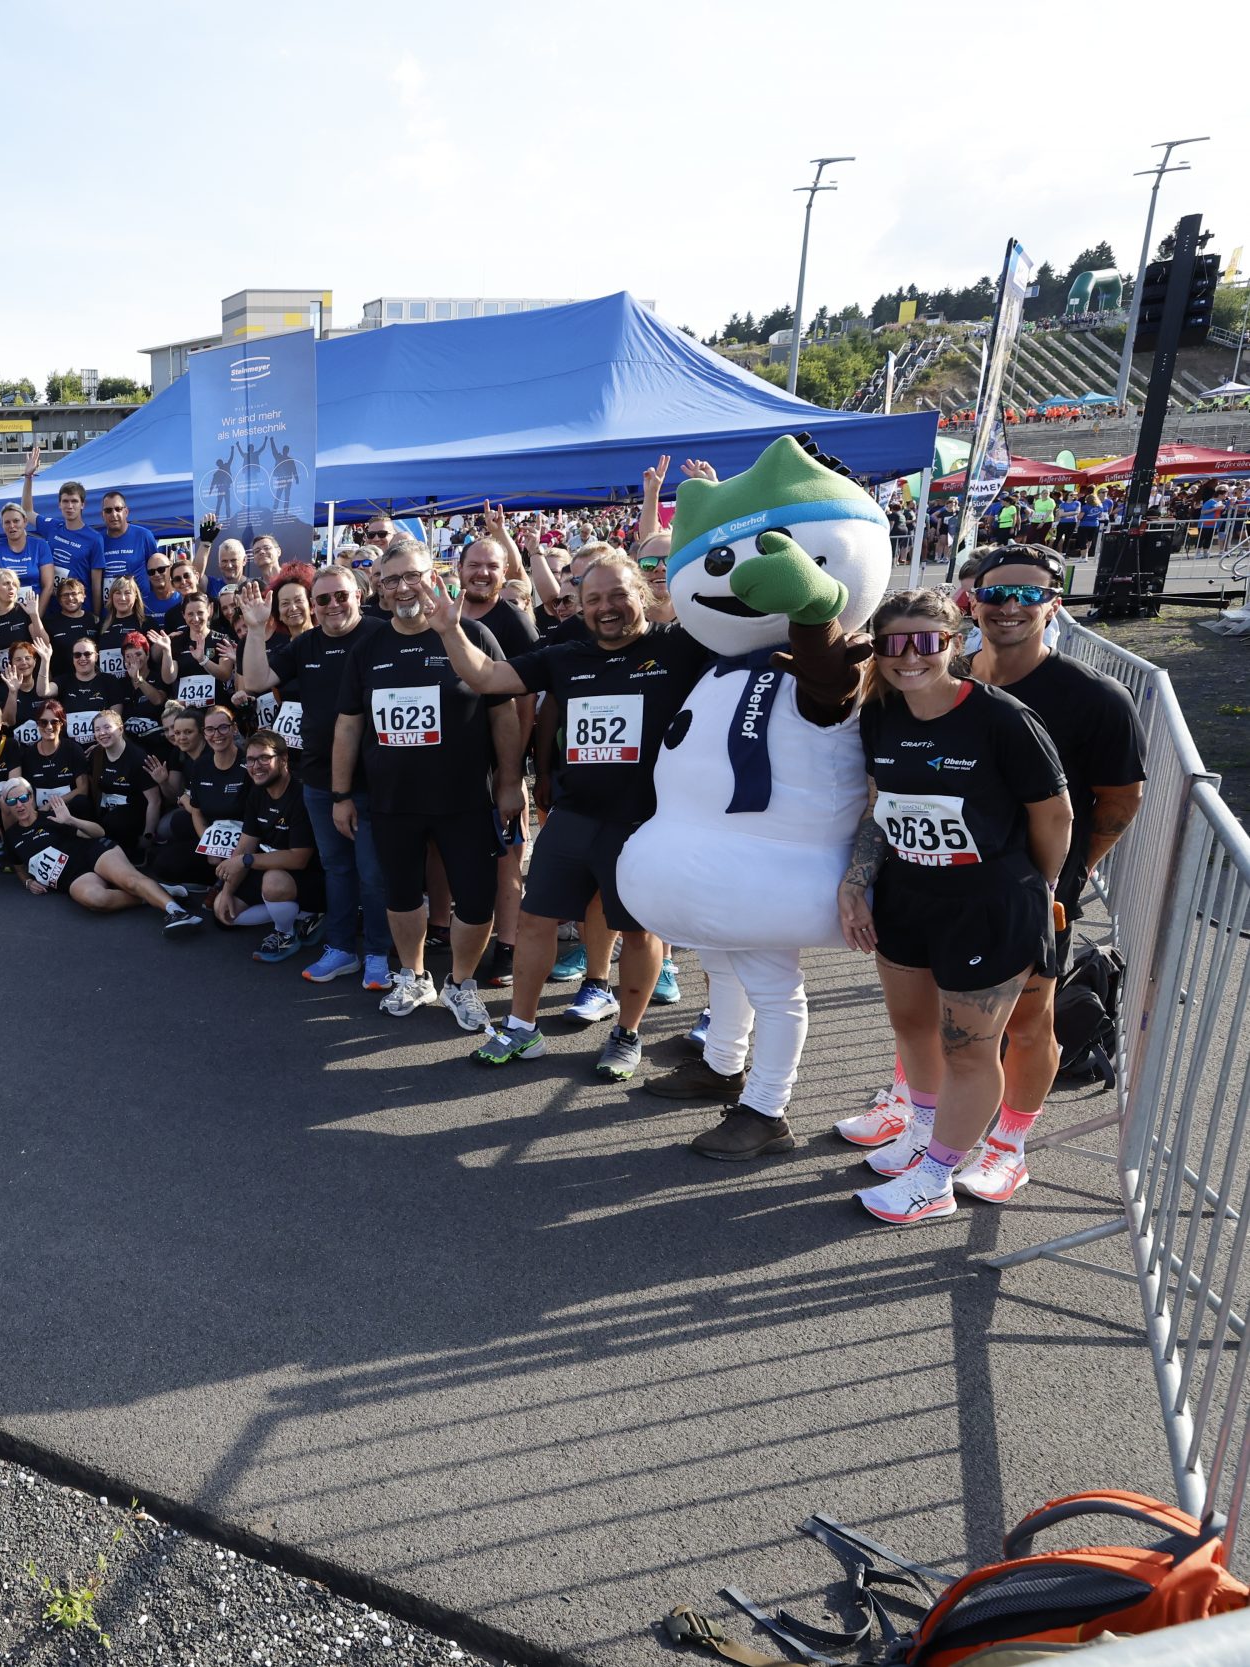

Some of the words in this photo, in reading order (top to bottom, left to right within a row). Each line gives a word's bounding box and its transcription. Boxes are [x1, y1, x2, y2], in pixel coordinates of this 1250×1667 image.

[230, 364, 270, 377] Steinmeyer
[221, 416, 236, 427] Wir
[237, 412, 256, 424] sind
[258, 410, 282, 422] mehr
[217, 430, 230, 441] als
[232, 422, 286, 438] Messtechnik
[1214, 459, 1250, 469] Hasseröde
[942, 482, 964, 491] Hasserö
[730, 513, 767, 532] Oberhof
[101, 658, 128, 673] 162
[629, 669, 668, 679] Zella-Mehlis
[179, 684, 214, 699] 4342
[741, 672, 775, 740] Oberhof
[375, 704, 437, 732] 1623
[387, 732, 426, 745] REWE
[576, 716, 627, 746] 852
[283, 735, 305, 748] EWE
[900, 741, 928, 749] CRAFT
[577, 747, 623, 761] REWE
[943, 758, 978, 768] Oberhof
[205, 829, 243, 847] 1633
[885, 816, 969, 852] 4635
[205, 845, 233, 858] REWE
[37, 852, 56, 882] 841
